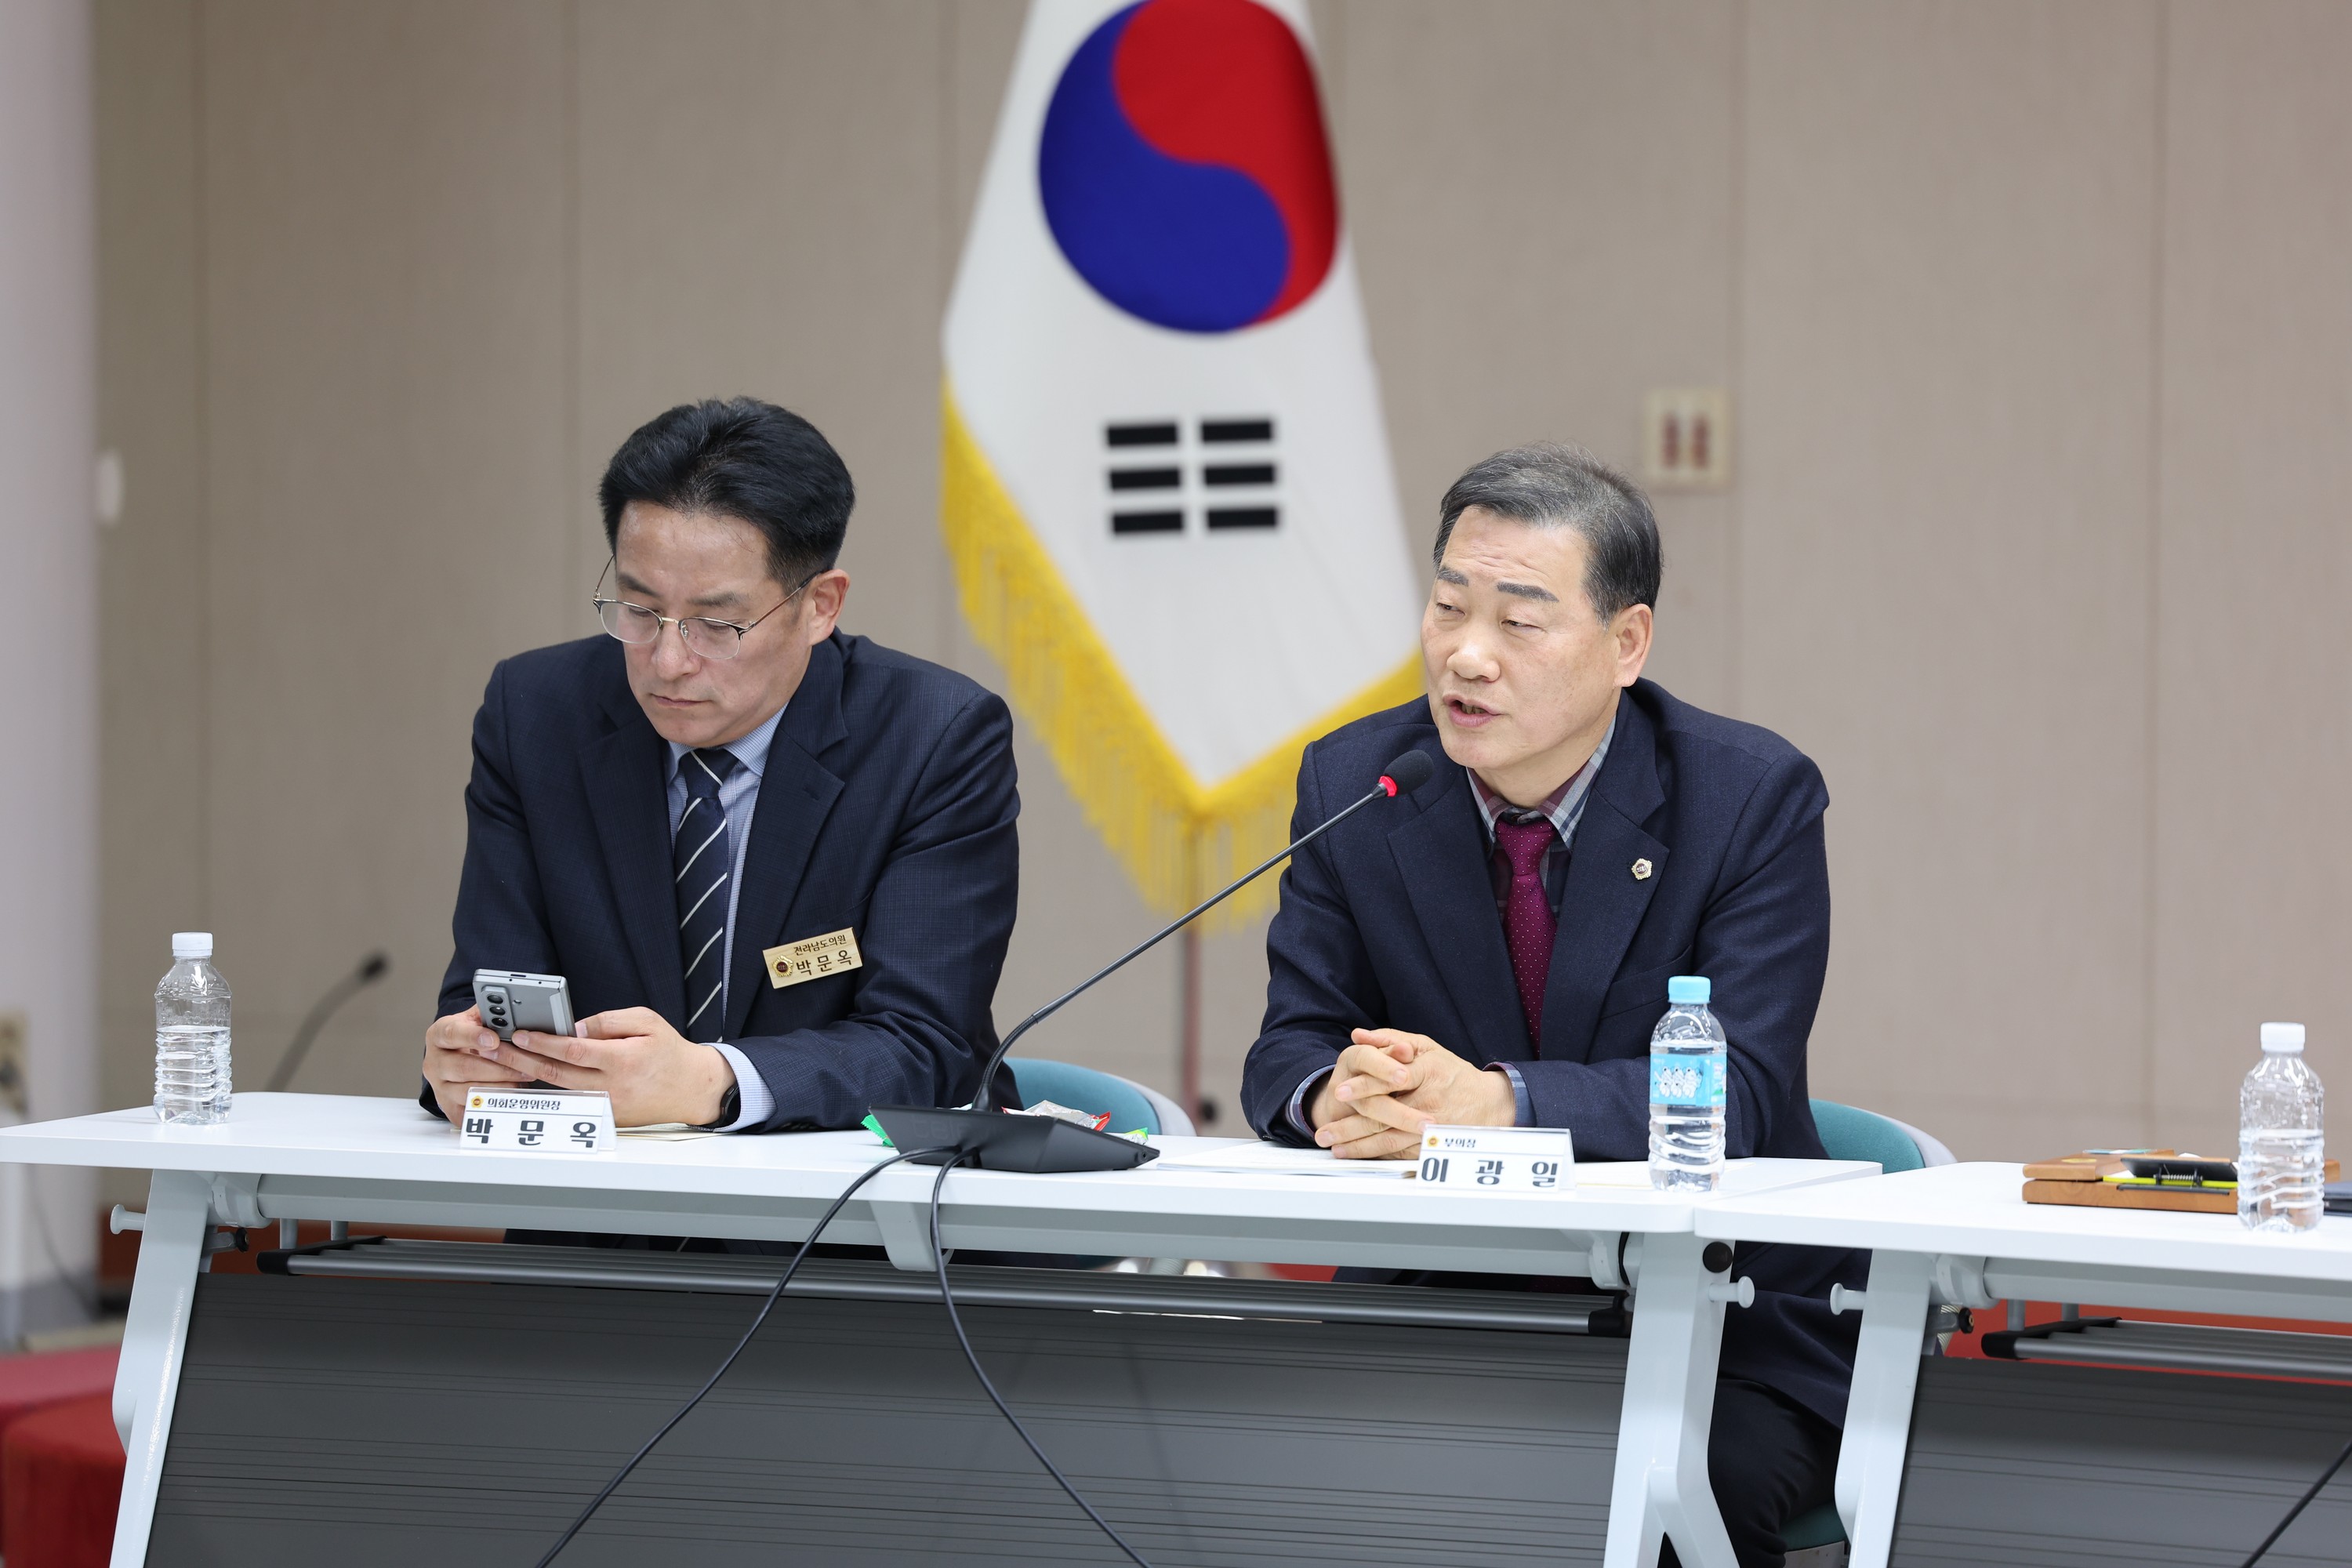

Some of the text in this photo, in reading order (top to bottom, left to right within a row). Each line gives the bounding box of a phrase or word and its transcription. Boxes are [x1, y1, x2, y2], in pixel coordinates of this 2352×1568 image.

[793, 935, 847, 956] 전라남도의원
[796, 949, 852, 976] 박 문 옥
[487, 1098, 561, 1111] 의회운영위원장
[466, 1118, 597, 1148] 박 문 옥
[1444, 1138, 1476, 1148] 부의장
[1421, 1157, 1558, 1188] 이 광 일
